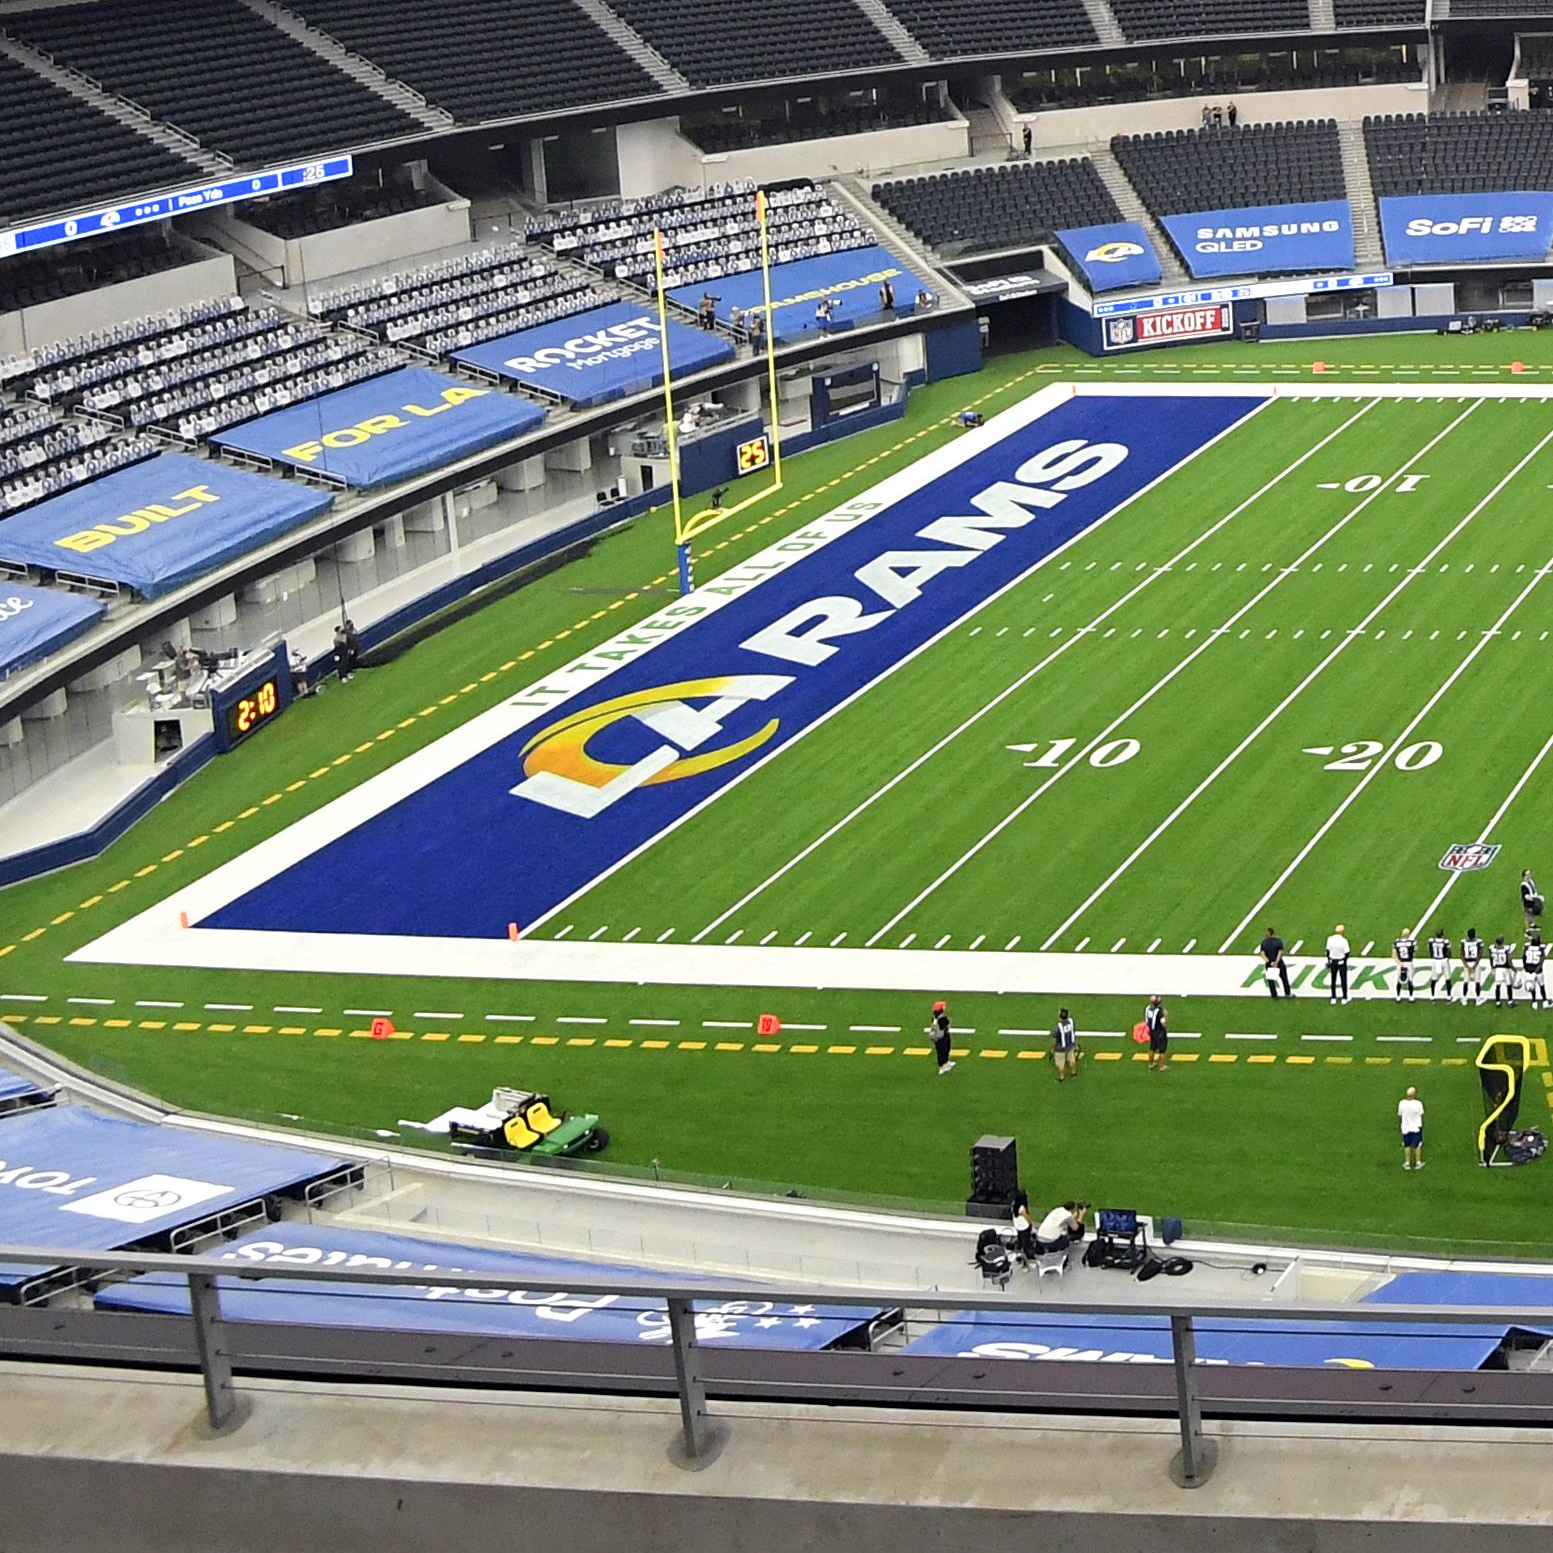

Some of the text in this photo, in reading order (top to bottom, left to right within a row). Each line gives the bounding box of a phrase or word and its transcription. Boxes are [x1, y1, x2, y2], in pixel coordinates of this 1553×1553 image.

[64, 179, 261, 237] 0 Pass Yds 0
[1196, 219, 1341, 241] SAMSUNG
[1405, 215, 1493, 237] SoFi
[1195, 240, 1265, 254] QLED
[1140, 309, 1217, 338] KICKOFF
[503, 315, 664, 375] ROCKET
[565, 335, 662, 372] Mortgage
[281, 385, 491, 464] FOR LA
[738, 437, 768, 472] 25
[1333, 473, 1432, 494] 10
[53, 484, 221, 555] BUILT
[738, 438, 1130, 668] RAMS
[510, 501, 883, 708] IT TAKES ALL OF US
[237, 682, 277, 733] 2:10
[1022, 737, 1142, 768] 10
[1323, 740, 1446, 772] 20
[1444, 854, 1487, 868] NFL
